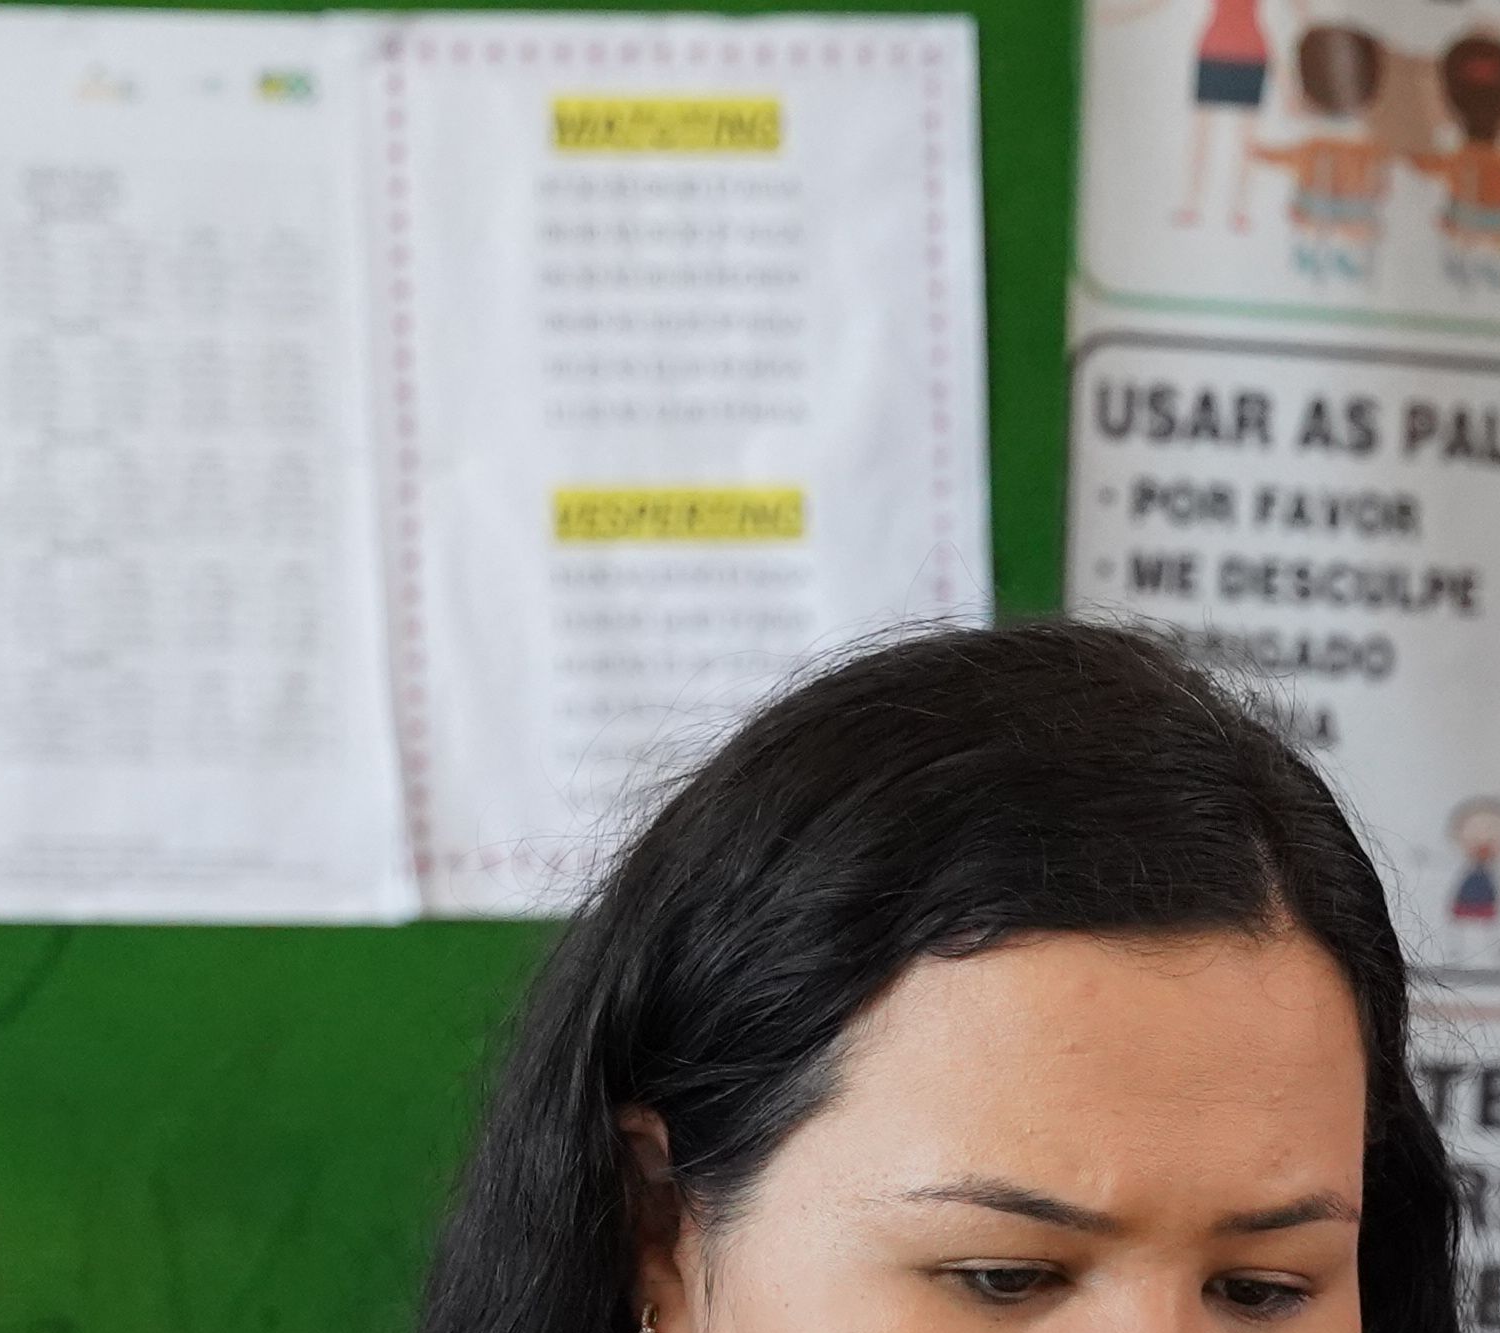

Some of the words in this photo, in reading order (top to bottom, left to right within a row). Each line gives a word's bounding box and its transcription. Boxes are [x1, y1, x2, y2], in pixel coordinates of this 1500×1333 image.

[1097, 384, 1274, 447] USAR
[1300, 390, 1380, 457] AS
[1130, 476, 1236, 530] POR
[1256, 486, 1420, 536] FAVOR
[1130, 552, 1200, 602] ME
[1218, 558, 1484, 618] DESCULPE
